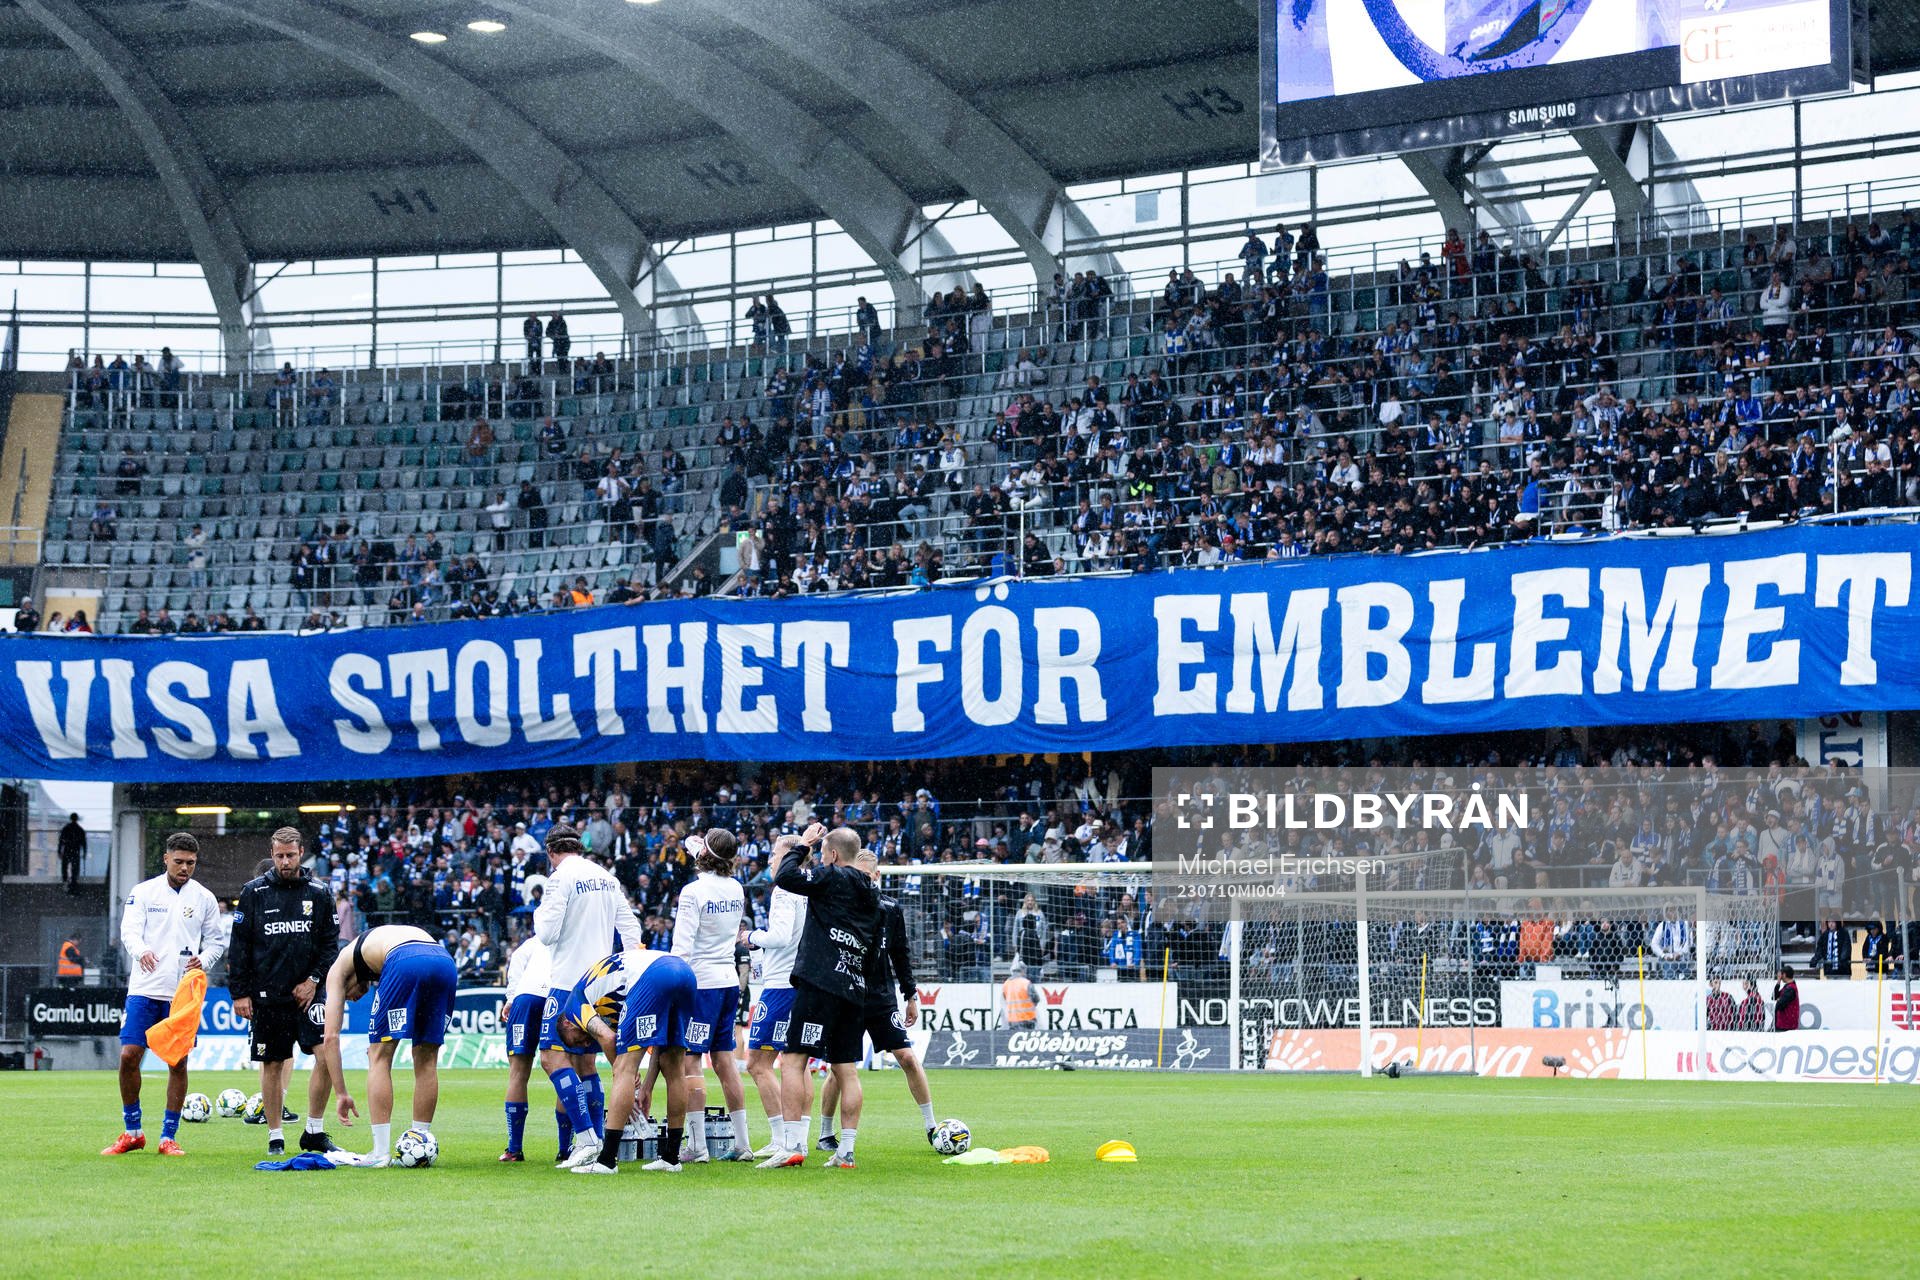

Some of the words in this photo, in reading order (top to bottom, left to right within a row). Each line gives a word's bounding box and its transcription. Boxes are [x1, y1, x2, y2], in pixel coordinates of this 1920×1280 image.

[1162, 86, 1243, 121] H3
[1509, 103, 1576, 125] SAMSUNG
[368, 188, 438, 215] H1
[15, 657, 301, 760] VISA
[328, 620, 850, 755] STOLTHET
[892, 582, 1107, 732] FÖR
[1153, 552, 1912, 717] EMBLEMET
[33, 1003, 85, 1022] Gamla
[1047, 1007, 1139, 1031] RASTA
[752, 1026, 760, 1036] 17
[1008, 1030, 1128, 1056] Göteborgs
